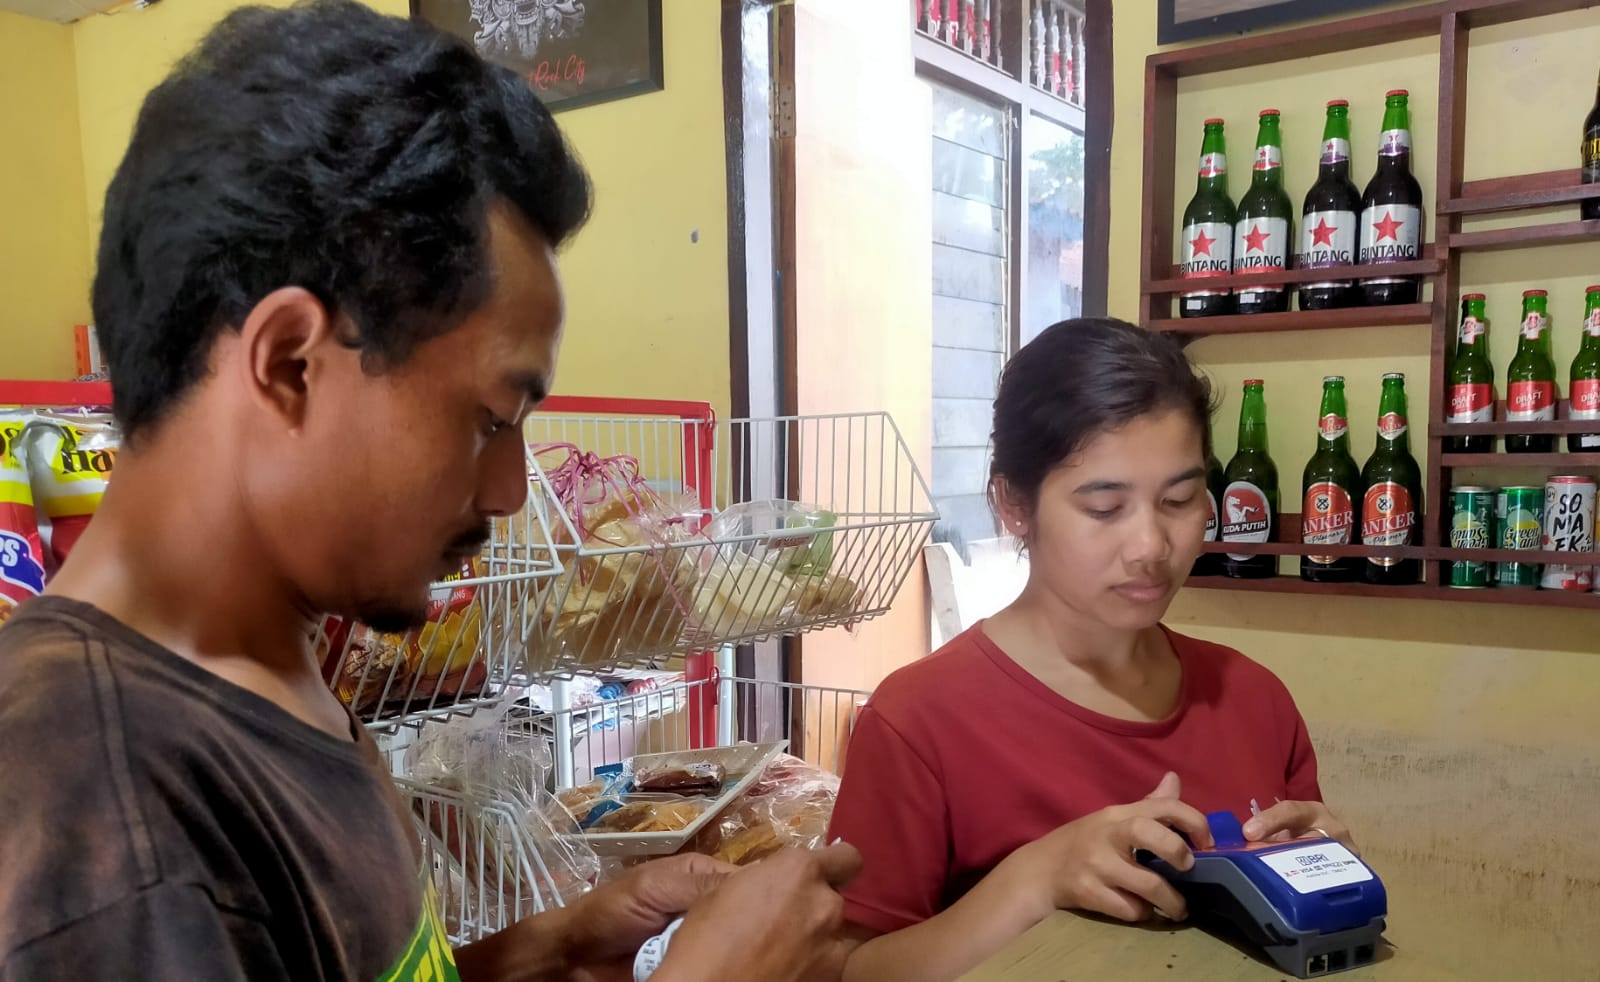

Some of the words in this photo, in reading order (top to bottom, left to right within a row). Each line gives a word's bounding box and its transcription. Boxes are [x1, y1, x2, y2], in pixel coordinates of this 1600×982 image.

[1361, 245, 1414, 261] BINTANG
[1181, 259, 1227, 274] BINTANG
[1515, 391, 1543, 405] DRAFT
[1559, 493, 1582, 514] SO
[1241, 519, 1267, 532] PUTIH
[1302, 510, 1354, 536] ANKER
[1361, 511, 1416, 537] ANKER
